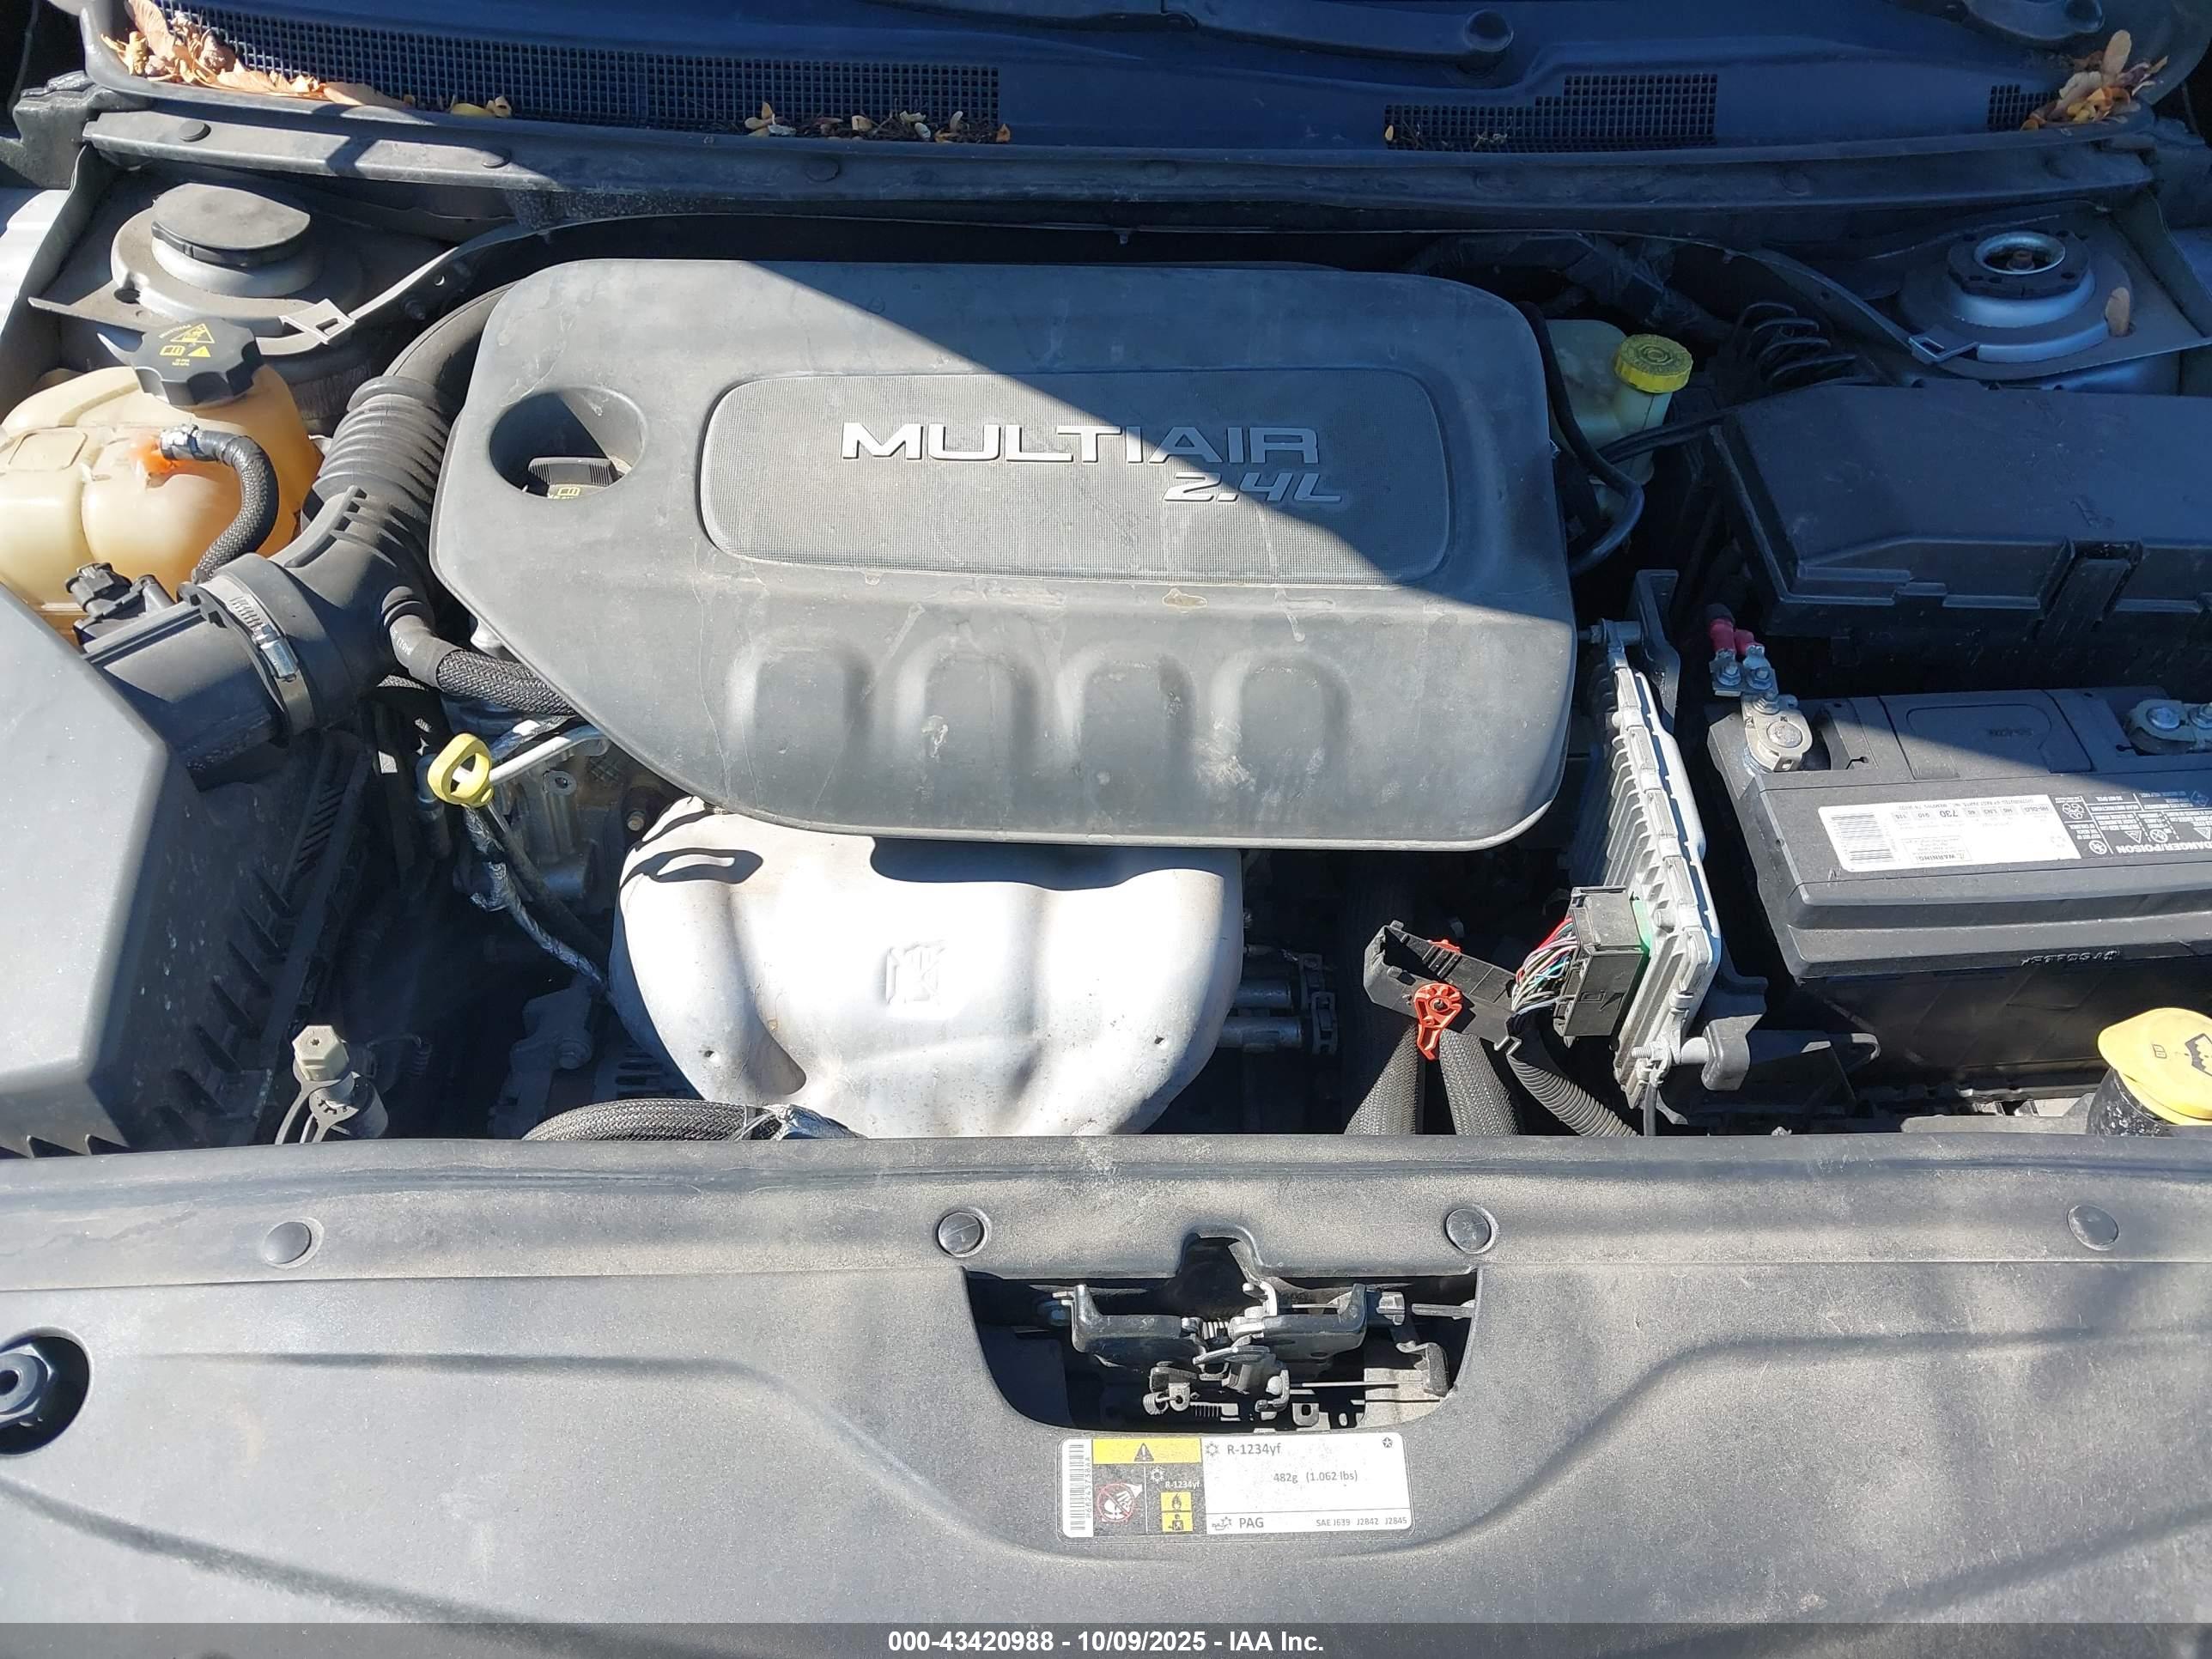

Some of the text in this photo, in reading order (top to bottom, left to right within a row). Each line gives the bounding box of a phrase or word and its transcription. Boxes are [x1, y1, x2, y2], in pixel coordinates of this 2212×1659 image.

[842, 422, 1319, 464] MULTIAIR
[1164, 471, 1342, 502] 2.4L
[2115, 841, 2212, 854] DANGER/POISON
[1227, 1443, 1281, 1456] R-1234yf
[1273, 1470, 1358, 1484] 482g (1.062 lbs)
[1165, 1480, 1200, 1490] R-1234yf
[1239, 1517, 1264, 1528] PAG
[1385, 1516, 1407, 1525] J2845
